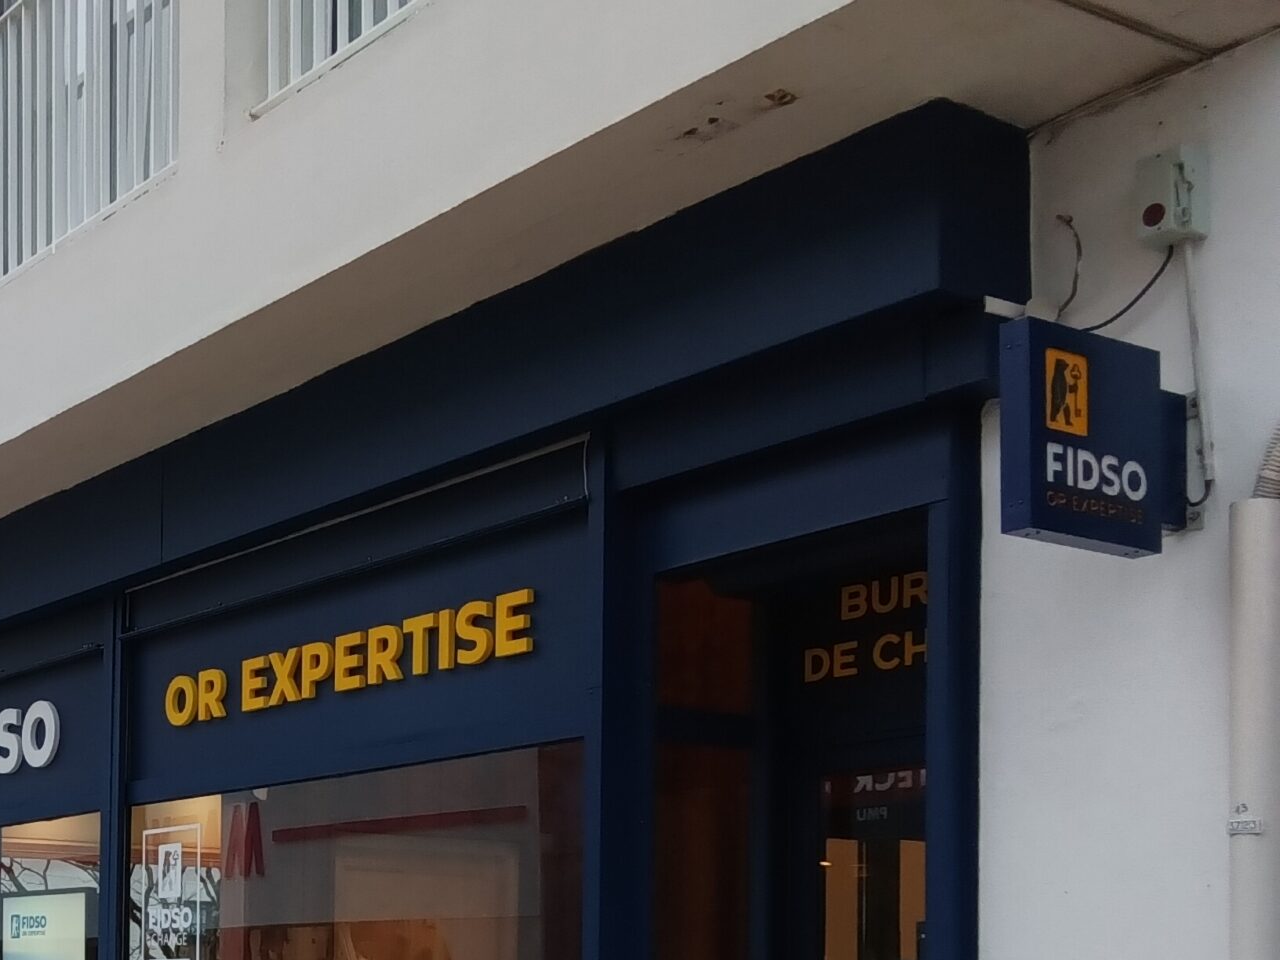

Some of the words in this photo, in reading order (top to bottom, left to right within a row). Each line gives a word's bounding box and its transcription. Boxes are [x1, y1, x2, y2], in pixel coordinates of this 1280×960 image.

[1046, 441, 1148, 501] FIDSO
[840, 571, 928, 620] BUR
[165, 668, 227, 727] OR
[242, 588, 535, 712] EXPERTISE
[804, 640, 858, 682] DE
[21, 916, 47, 929] FIDSO
[147, 906, 193, 930] FIDSO
